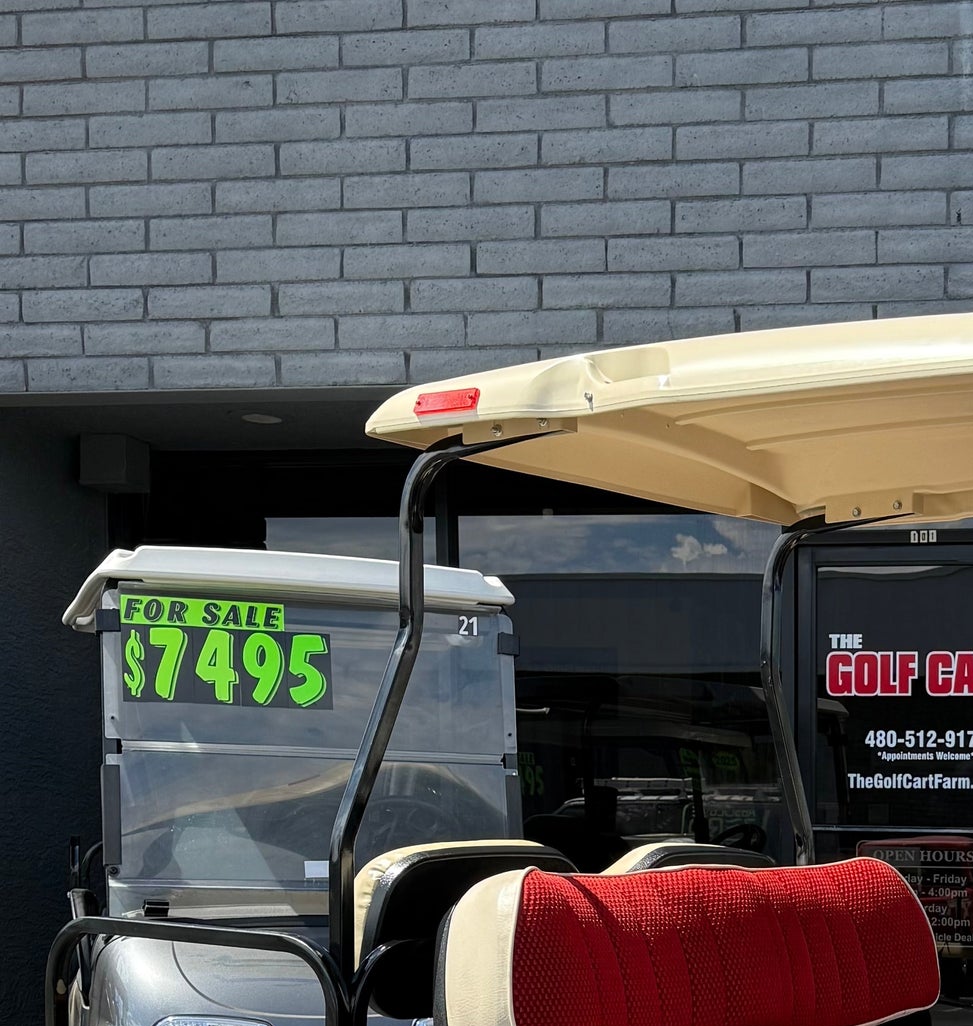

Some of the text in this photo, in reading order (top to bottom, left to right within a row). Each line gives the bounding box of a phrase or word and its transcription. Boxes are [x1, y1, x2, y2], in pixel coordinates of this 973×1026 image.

[910, 530, 937, 543] 101
[124, 598, 281, 629] FOR SALE
[459, 615, 478, 636] 21
[829, 634, 862, 649] THE
[123, 627, 329, 708] $7495
[826, 651, 918, 696] GOLF
[873, 850, 915, 861] OPEN
[933, 874, 967, 886] Friday
[928, 887, 968, 898] 4:00pm
[931, 917, 971, 929] 2:00pm
